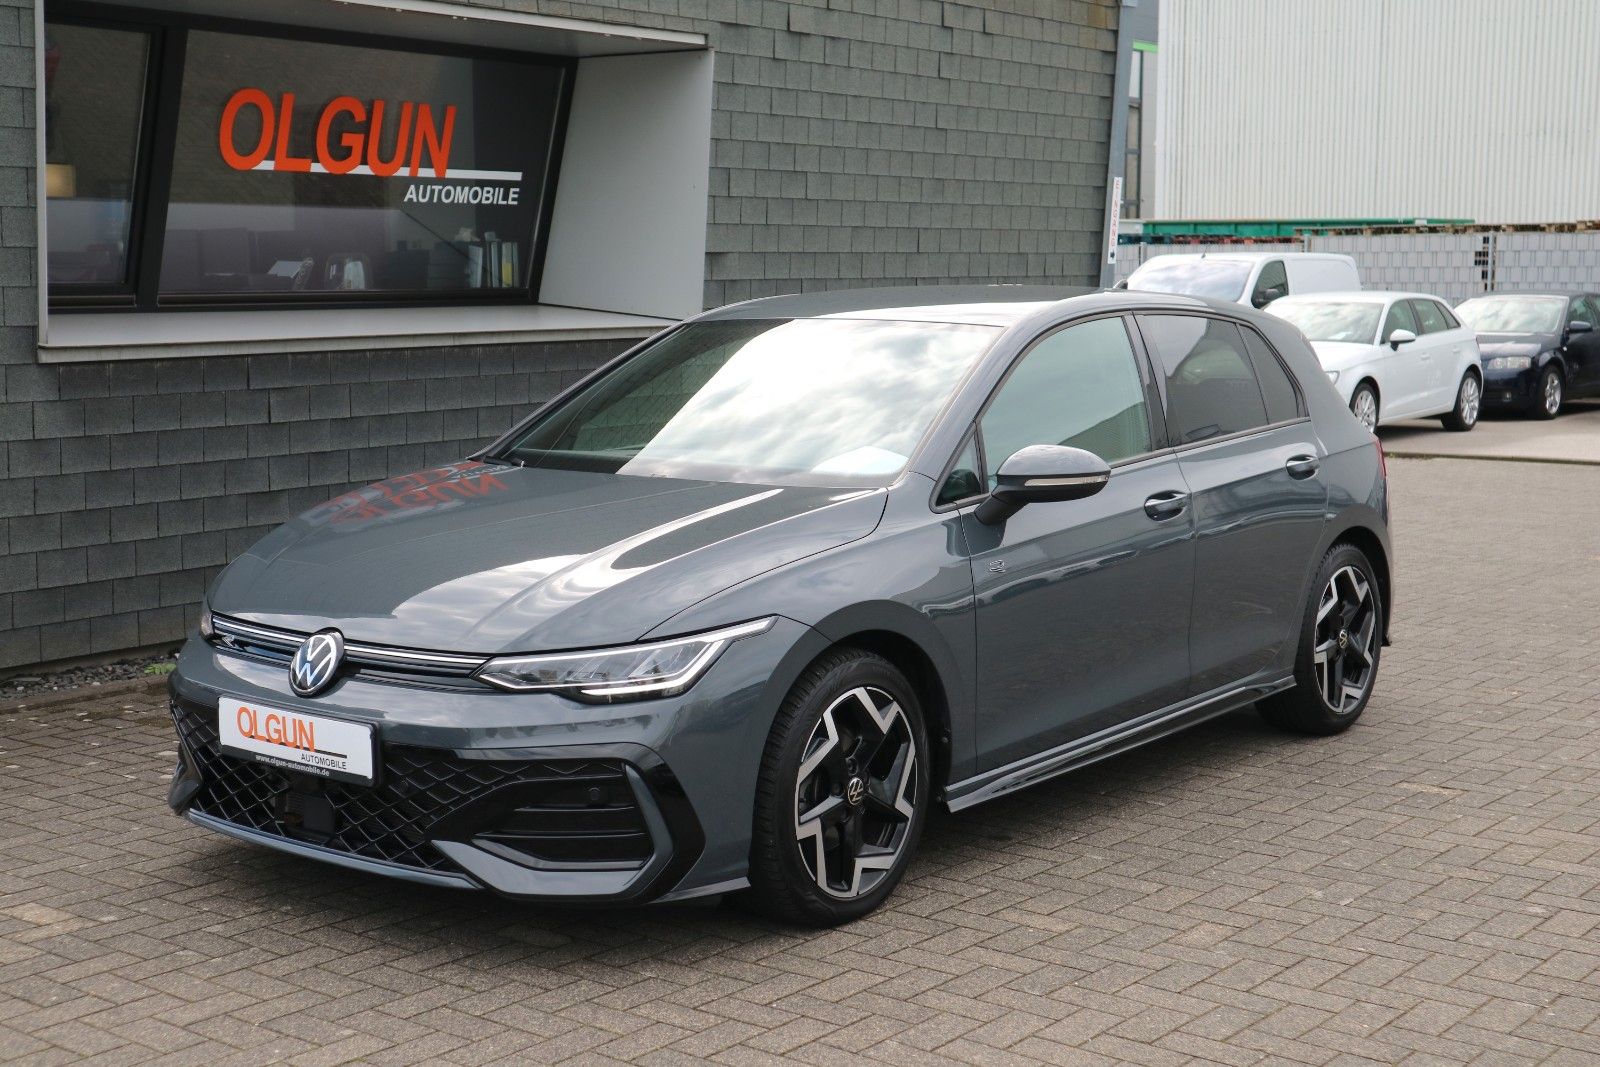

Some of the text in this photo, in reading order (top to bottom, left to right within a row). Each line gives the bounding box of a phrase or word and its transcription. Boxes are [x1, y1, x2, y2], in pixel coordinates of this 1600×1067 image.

[219, 87, 457, 179] OLGUN
[404, 184, 519, 205] AUTOMOBILE
[236, 706, 316, 752] OLGUN
[255, 754, 330, 777] www.olgun-automobile.de
[300, 753, 347, 770] AUTOMOBILE
